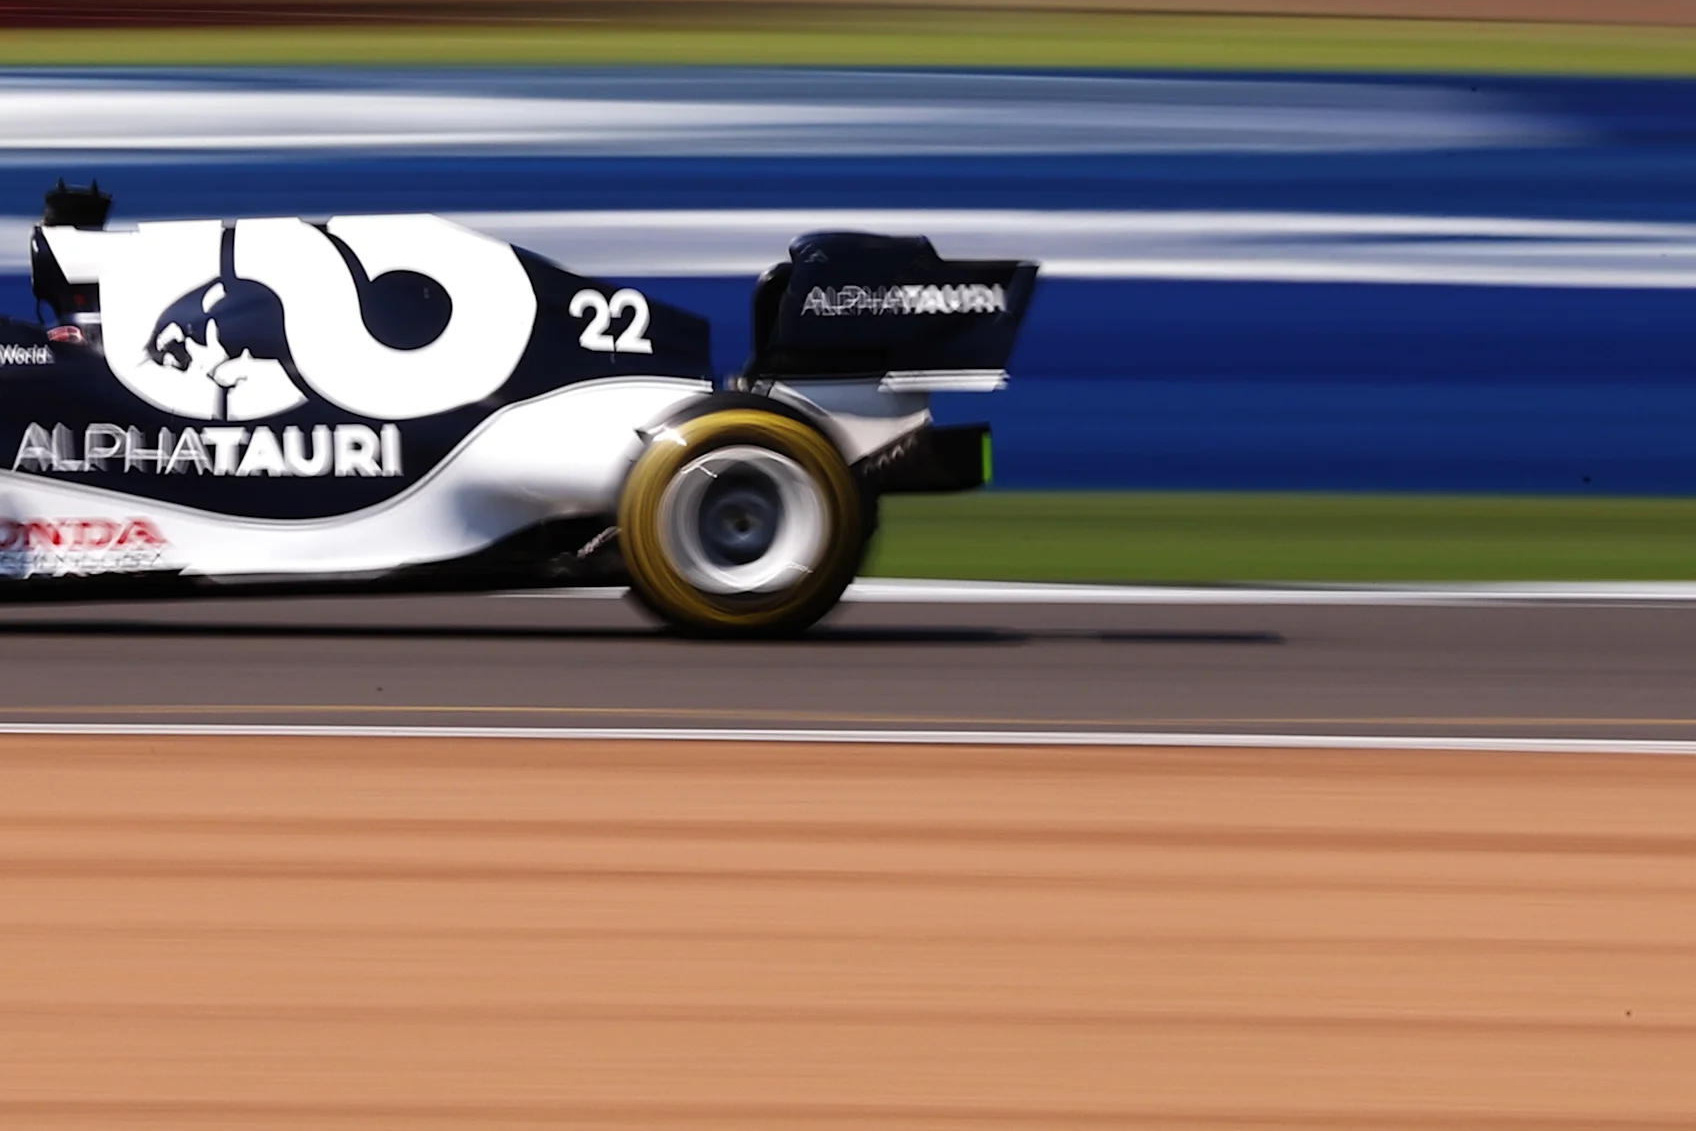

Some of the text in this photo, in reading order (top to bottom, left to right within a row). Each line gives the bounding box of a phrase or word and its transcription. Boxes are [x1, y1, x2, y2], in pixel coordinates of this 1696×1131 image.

[569, 288, 653, 354] 22
[801, 283, 1006, 316] ALPHATAURI
[12, 422, 403, 477] ALPHATAURI
